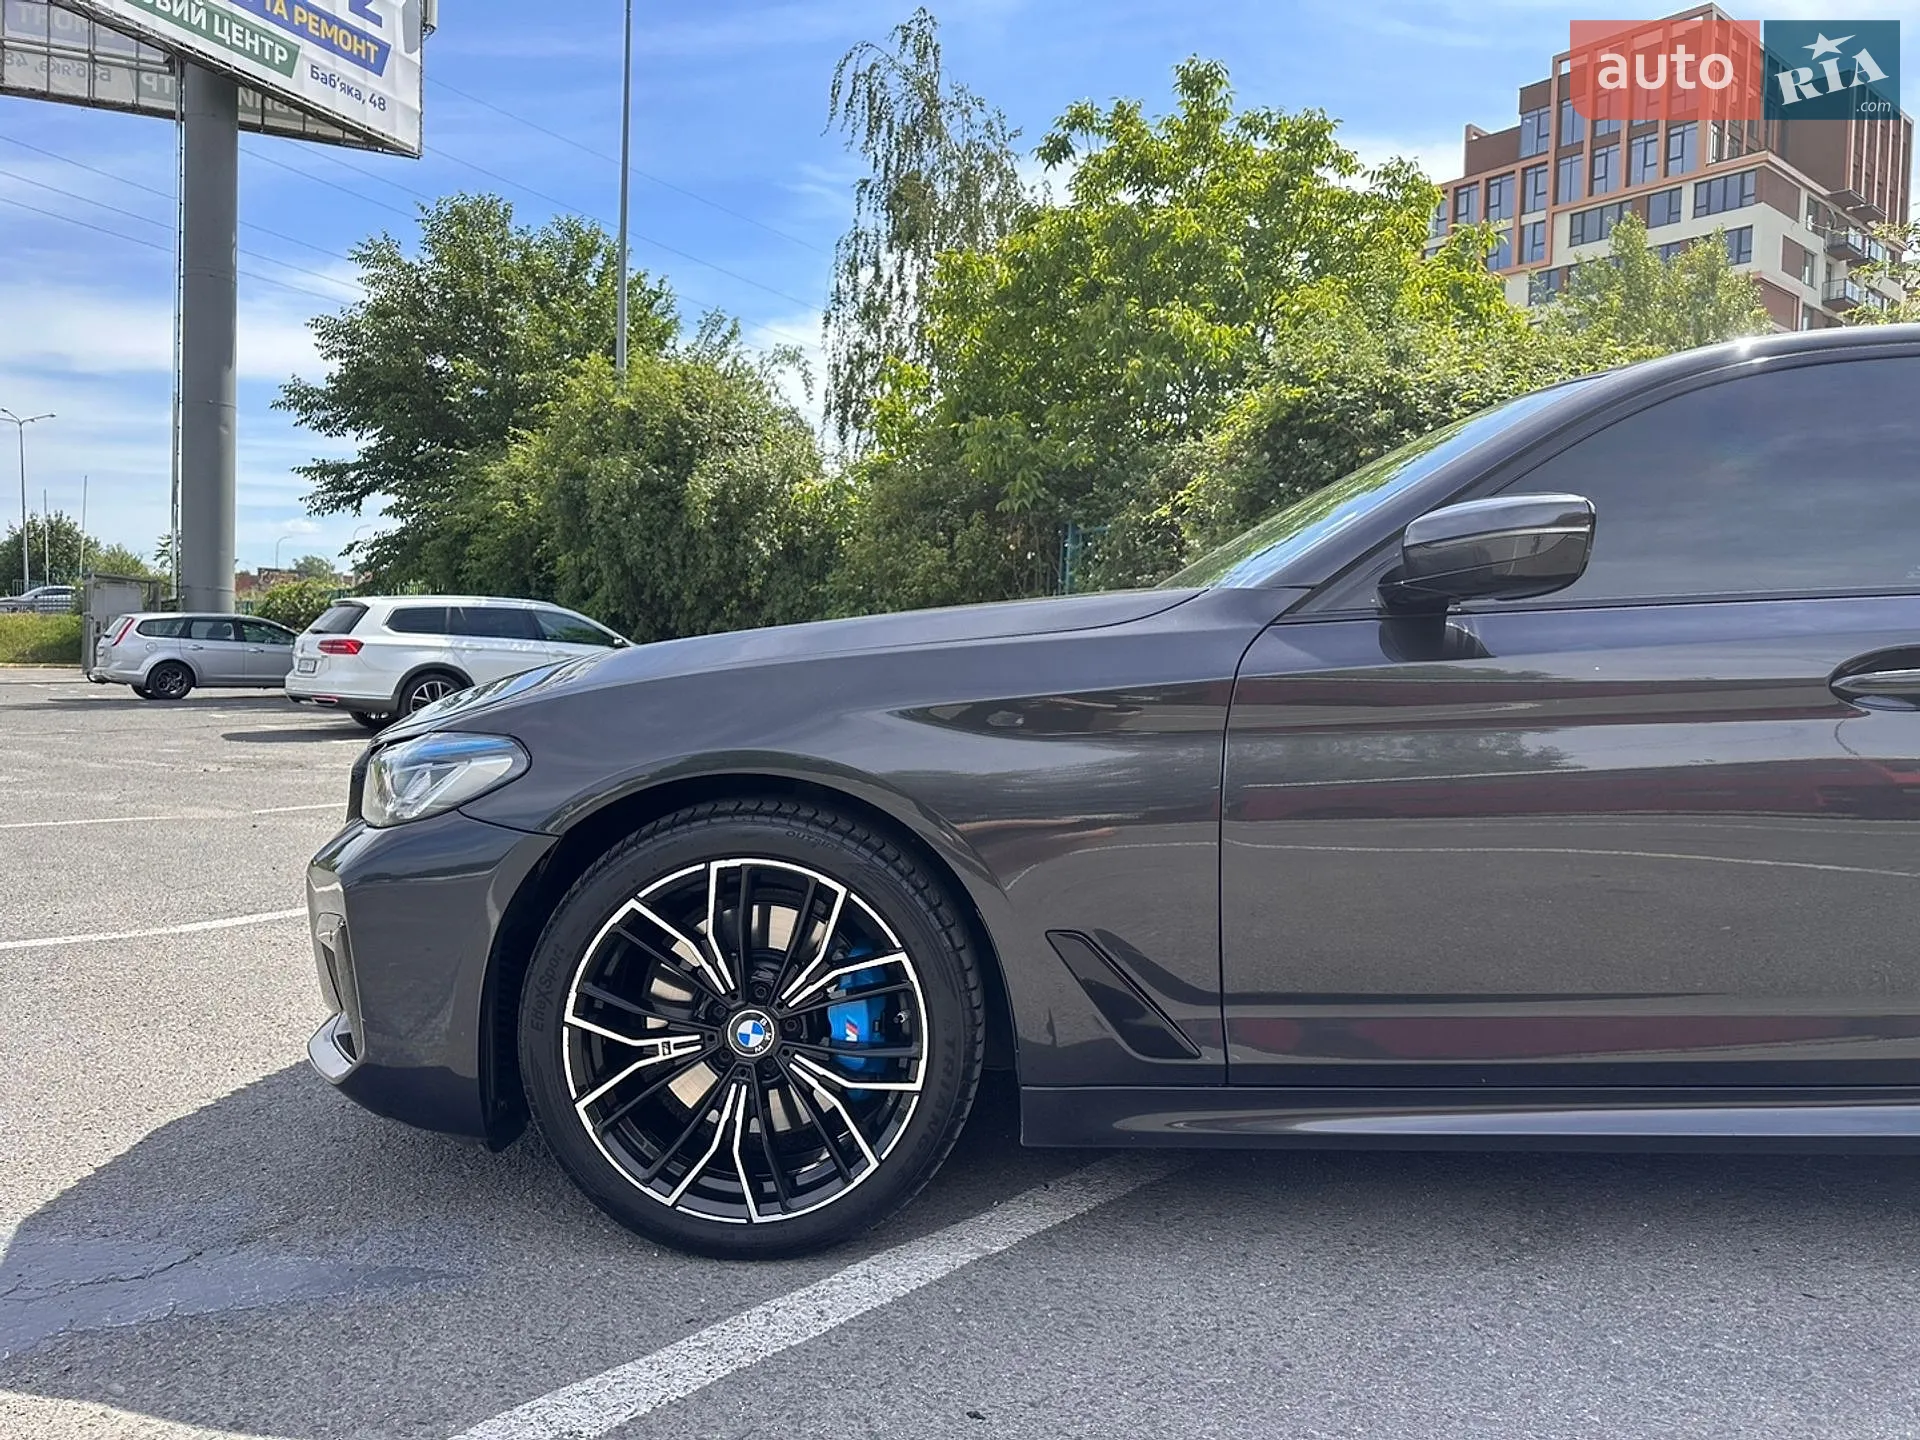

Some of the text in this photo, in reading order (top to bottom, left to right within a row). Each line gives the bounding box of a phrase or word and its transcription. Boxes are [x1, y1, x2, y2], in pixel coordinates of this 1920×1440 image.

[214, 13, 288, 65] ЦЕНТР
[294, 4, 378, 64] РЕМОНТ
[310, 63, 365, 104] Баб'яка,
[369, 92, 387, 112] 48
